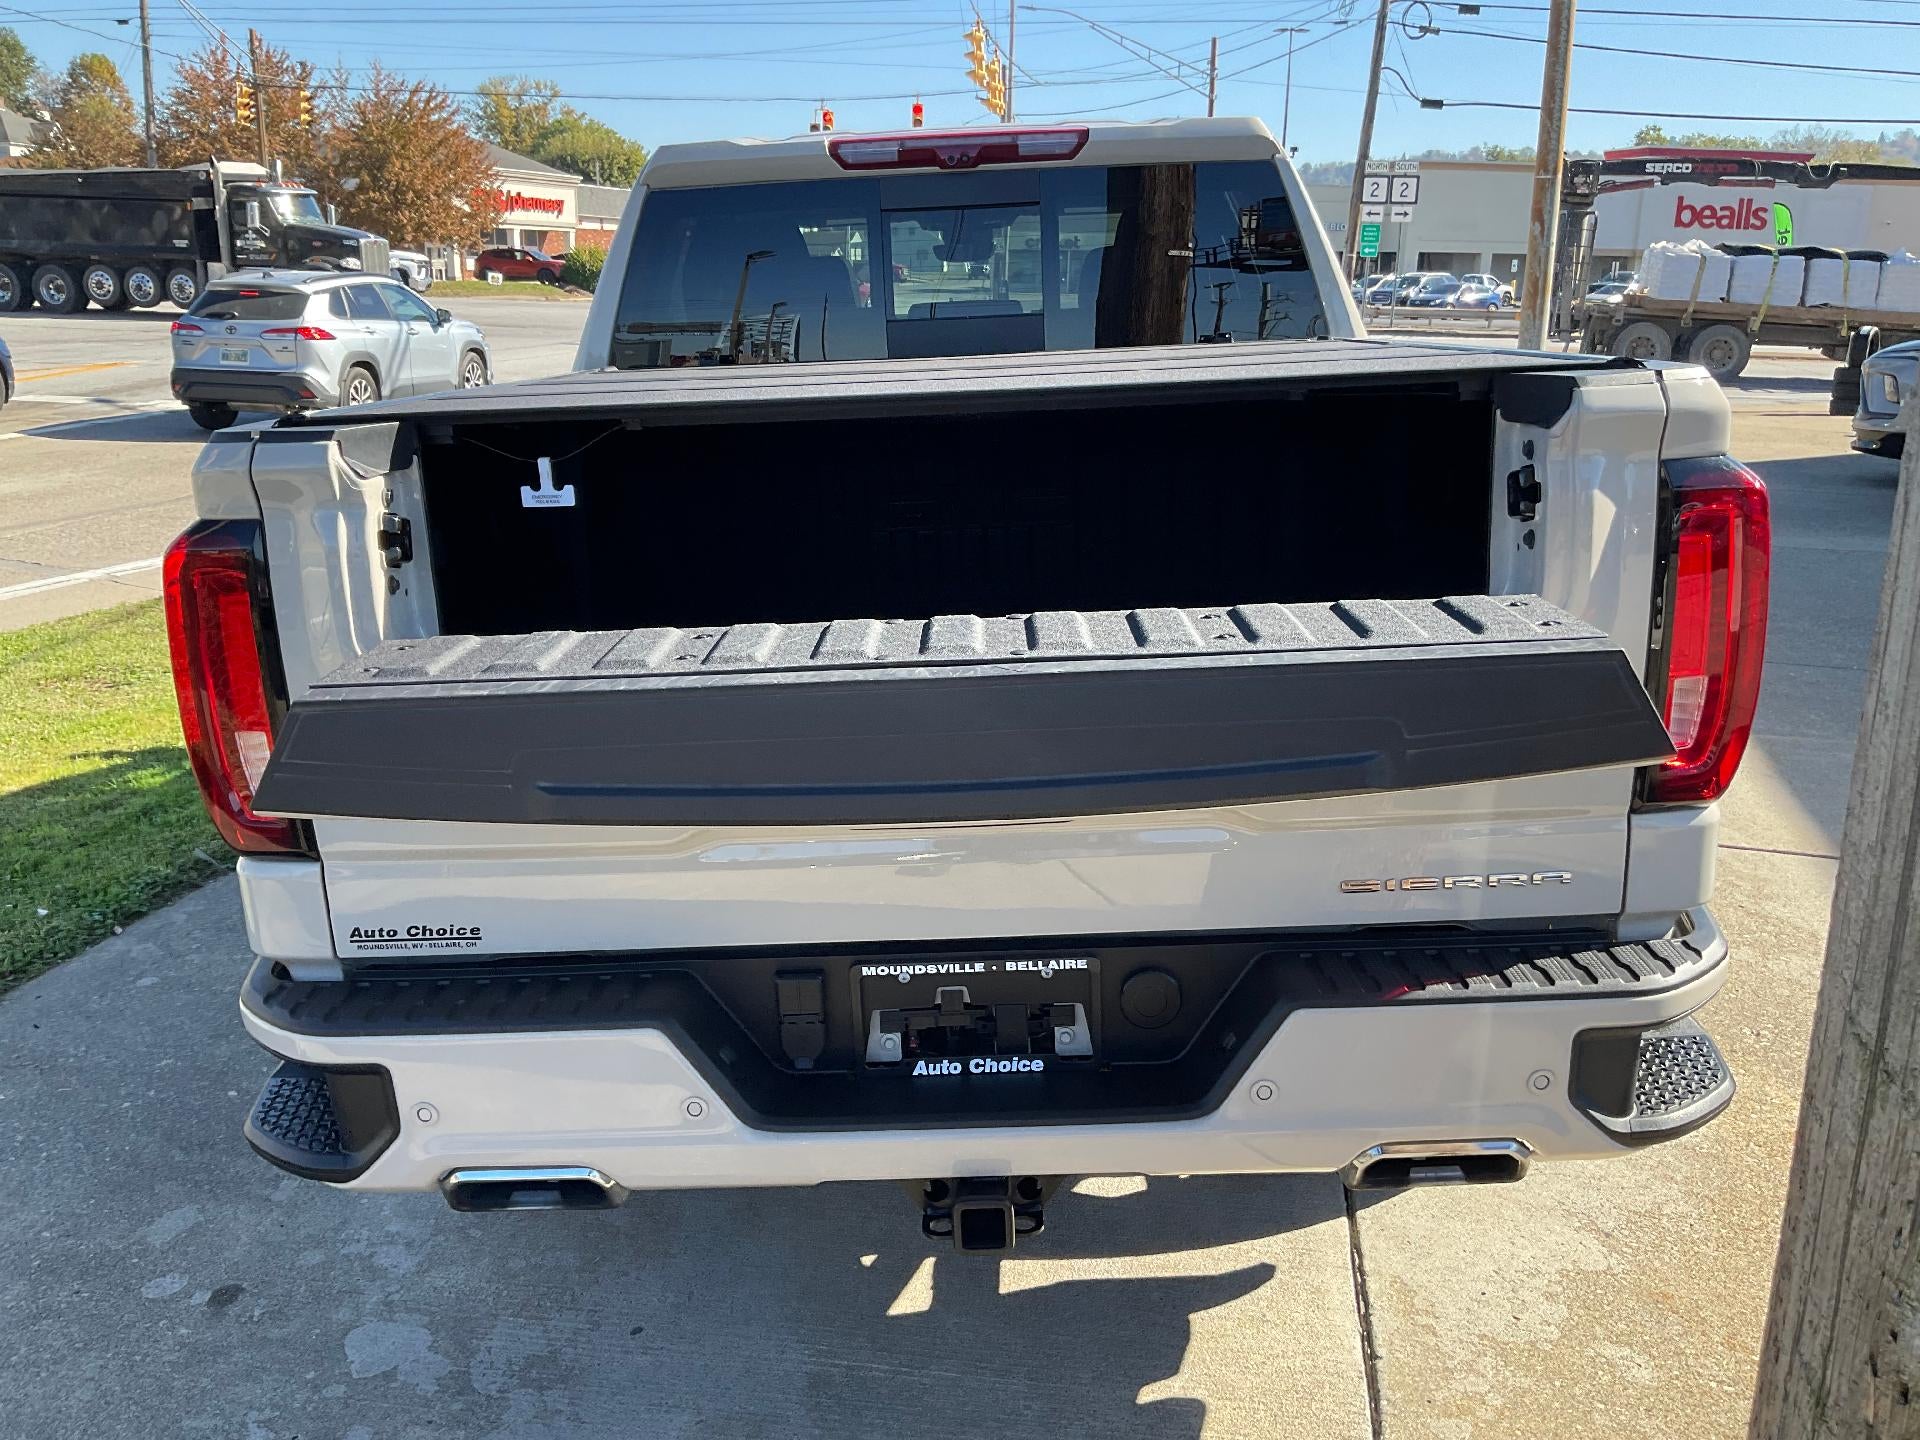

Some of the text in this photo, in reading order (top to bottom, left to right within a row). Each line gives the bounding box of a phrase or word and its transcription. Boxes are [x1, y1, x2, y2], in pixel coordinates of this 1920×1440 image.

[1396, 163, 1417, 171] SOUTH
[1645, 162, 1692, 173] SERCO
[1370, 182, 1380, 198] 2
[1399, 182, 1409, 198] 2
[1674, 195, 1768, 231] bealls
[1340, 871, 1571, 893] SIERRA
[349, 924, 481, 939] Auto Choice
[861, 959, 1088, 976] MOUNDSVILLE BELLAIRE
[912, 1056, 1044, 1076] Auto Choice
